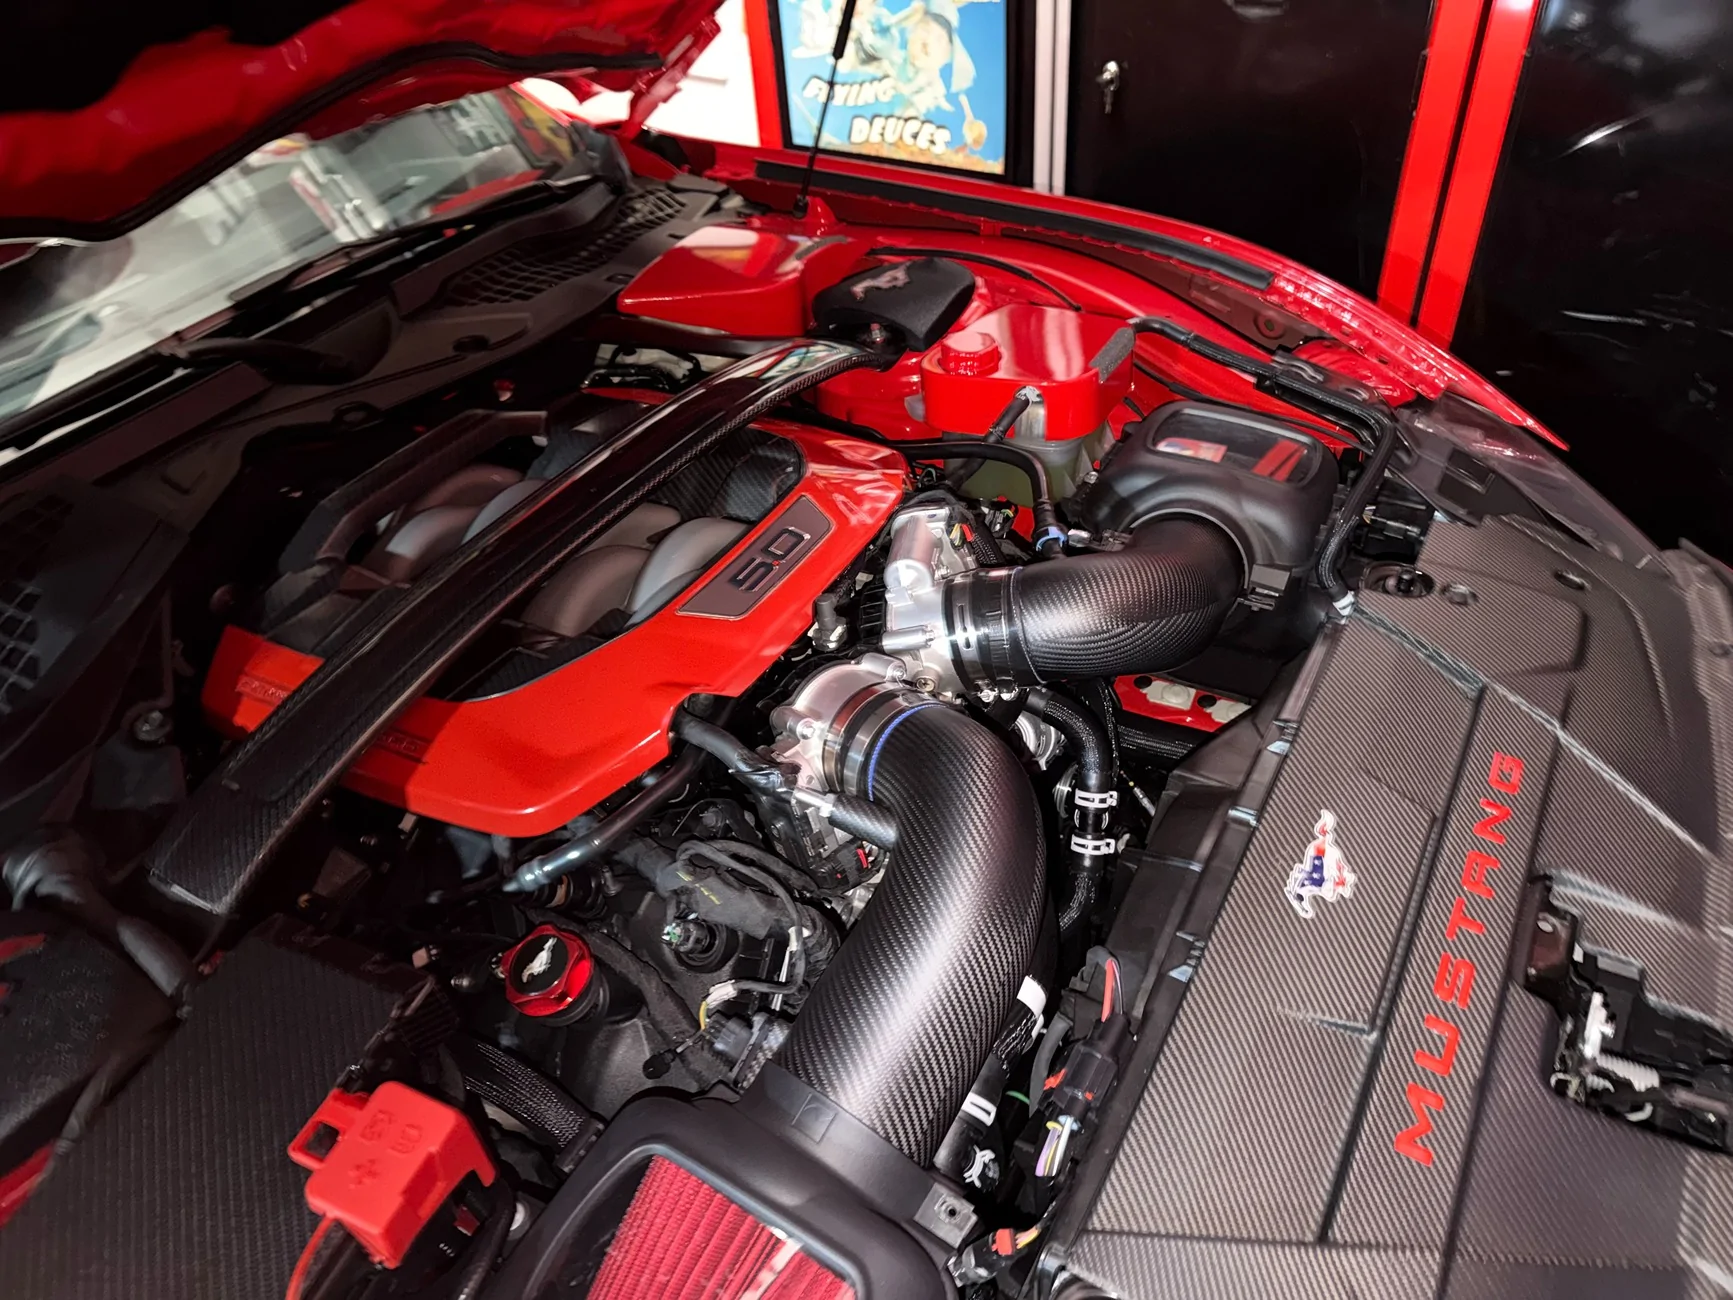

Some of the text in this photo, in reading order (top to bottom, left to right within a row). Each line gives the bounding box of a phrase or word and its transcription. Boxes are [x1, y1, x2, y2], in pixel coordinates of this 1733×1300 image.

[850, 115, 952, 154] DEUCES
[728, 526, 811, 592] 5.0
[1394, 751, 1525, 1167] MUSTANG
